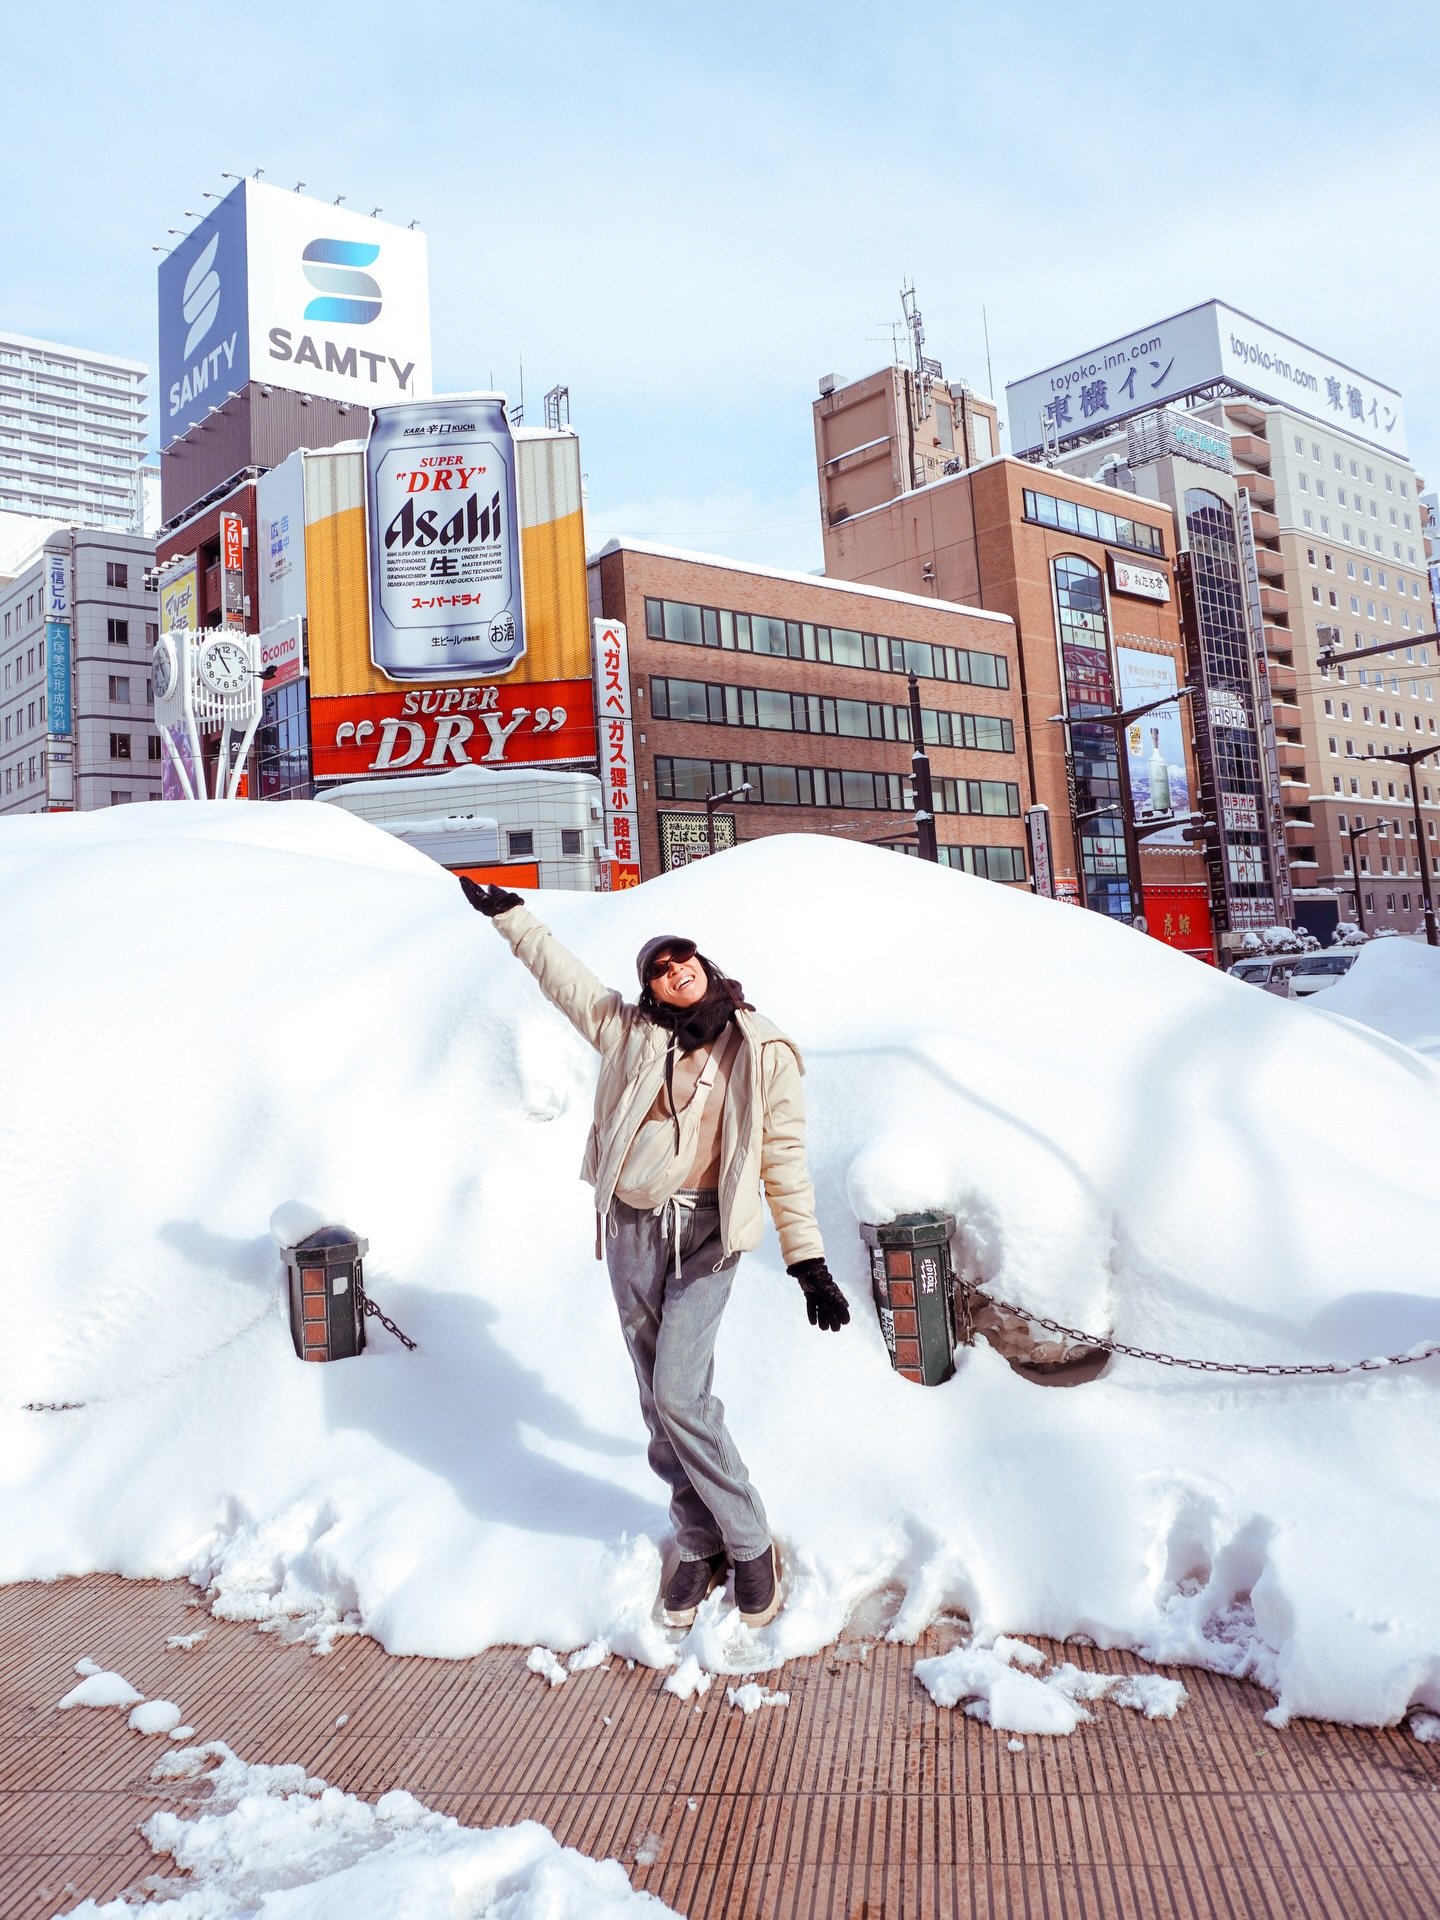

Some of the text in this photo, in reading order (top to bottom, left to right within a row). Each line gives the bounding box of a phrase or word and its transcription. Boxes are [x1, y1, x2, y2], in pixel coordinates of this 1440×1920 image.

[268, 327, 415, 391] SAMTY
[1050, 337, 1162, 391] toyoko-inn.com
[1229, 332, 1319, 393] toyoko-inn.com
[169, 331, 238, 417] SAMTY
[1044, 356, 1175, 431] 東横イン
[1324, 375, 1397, 433] 東横イン
[426, 424, 451, 434] 辛口
[452, 423, 476, 431] KUCHI
[420, 456, 463, 467] SUPER
[270, 514, 289, 541] 広告
[385, 490, 501, 550] Asahi
[227, 519, 241, 568] 2Mビル
[430, 555, 459, 577] 生
[51, 557, 66, 611] 三信ビル
[411, 593, 481, 609] スーパードライ
[431, 635, 462, 647] 生ビール
[490, 622, 514, 643] お酒
[208, 653, 217, 661] 10
[222, 646, 231, 654] 12
[238, 656, 244, 664] 2
[261, 637, 295, 663] ocomo
[206, 661, 212, 669] 9
[209, 670, 215, 678] 8
[215, 677, 221, 685] 7
[232, 679, 238, 687] 5
[402, 686, 500, 716] SUPER
[923, 1258, 935, 1294] RIDICULE
